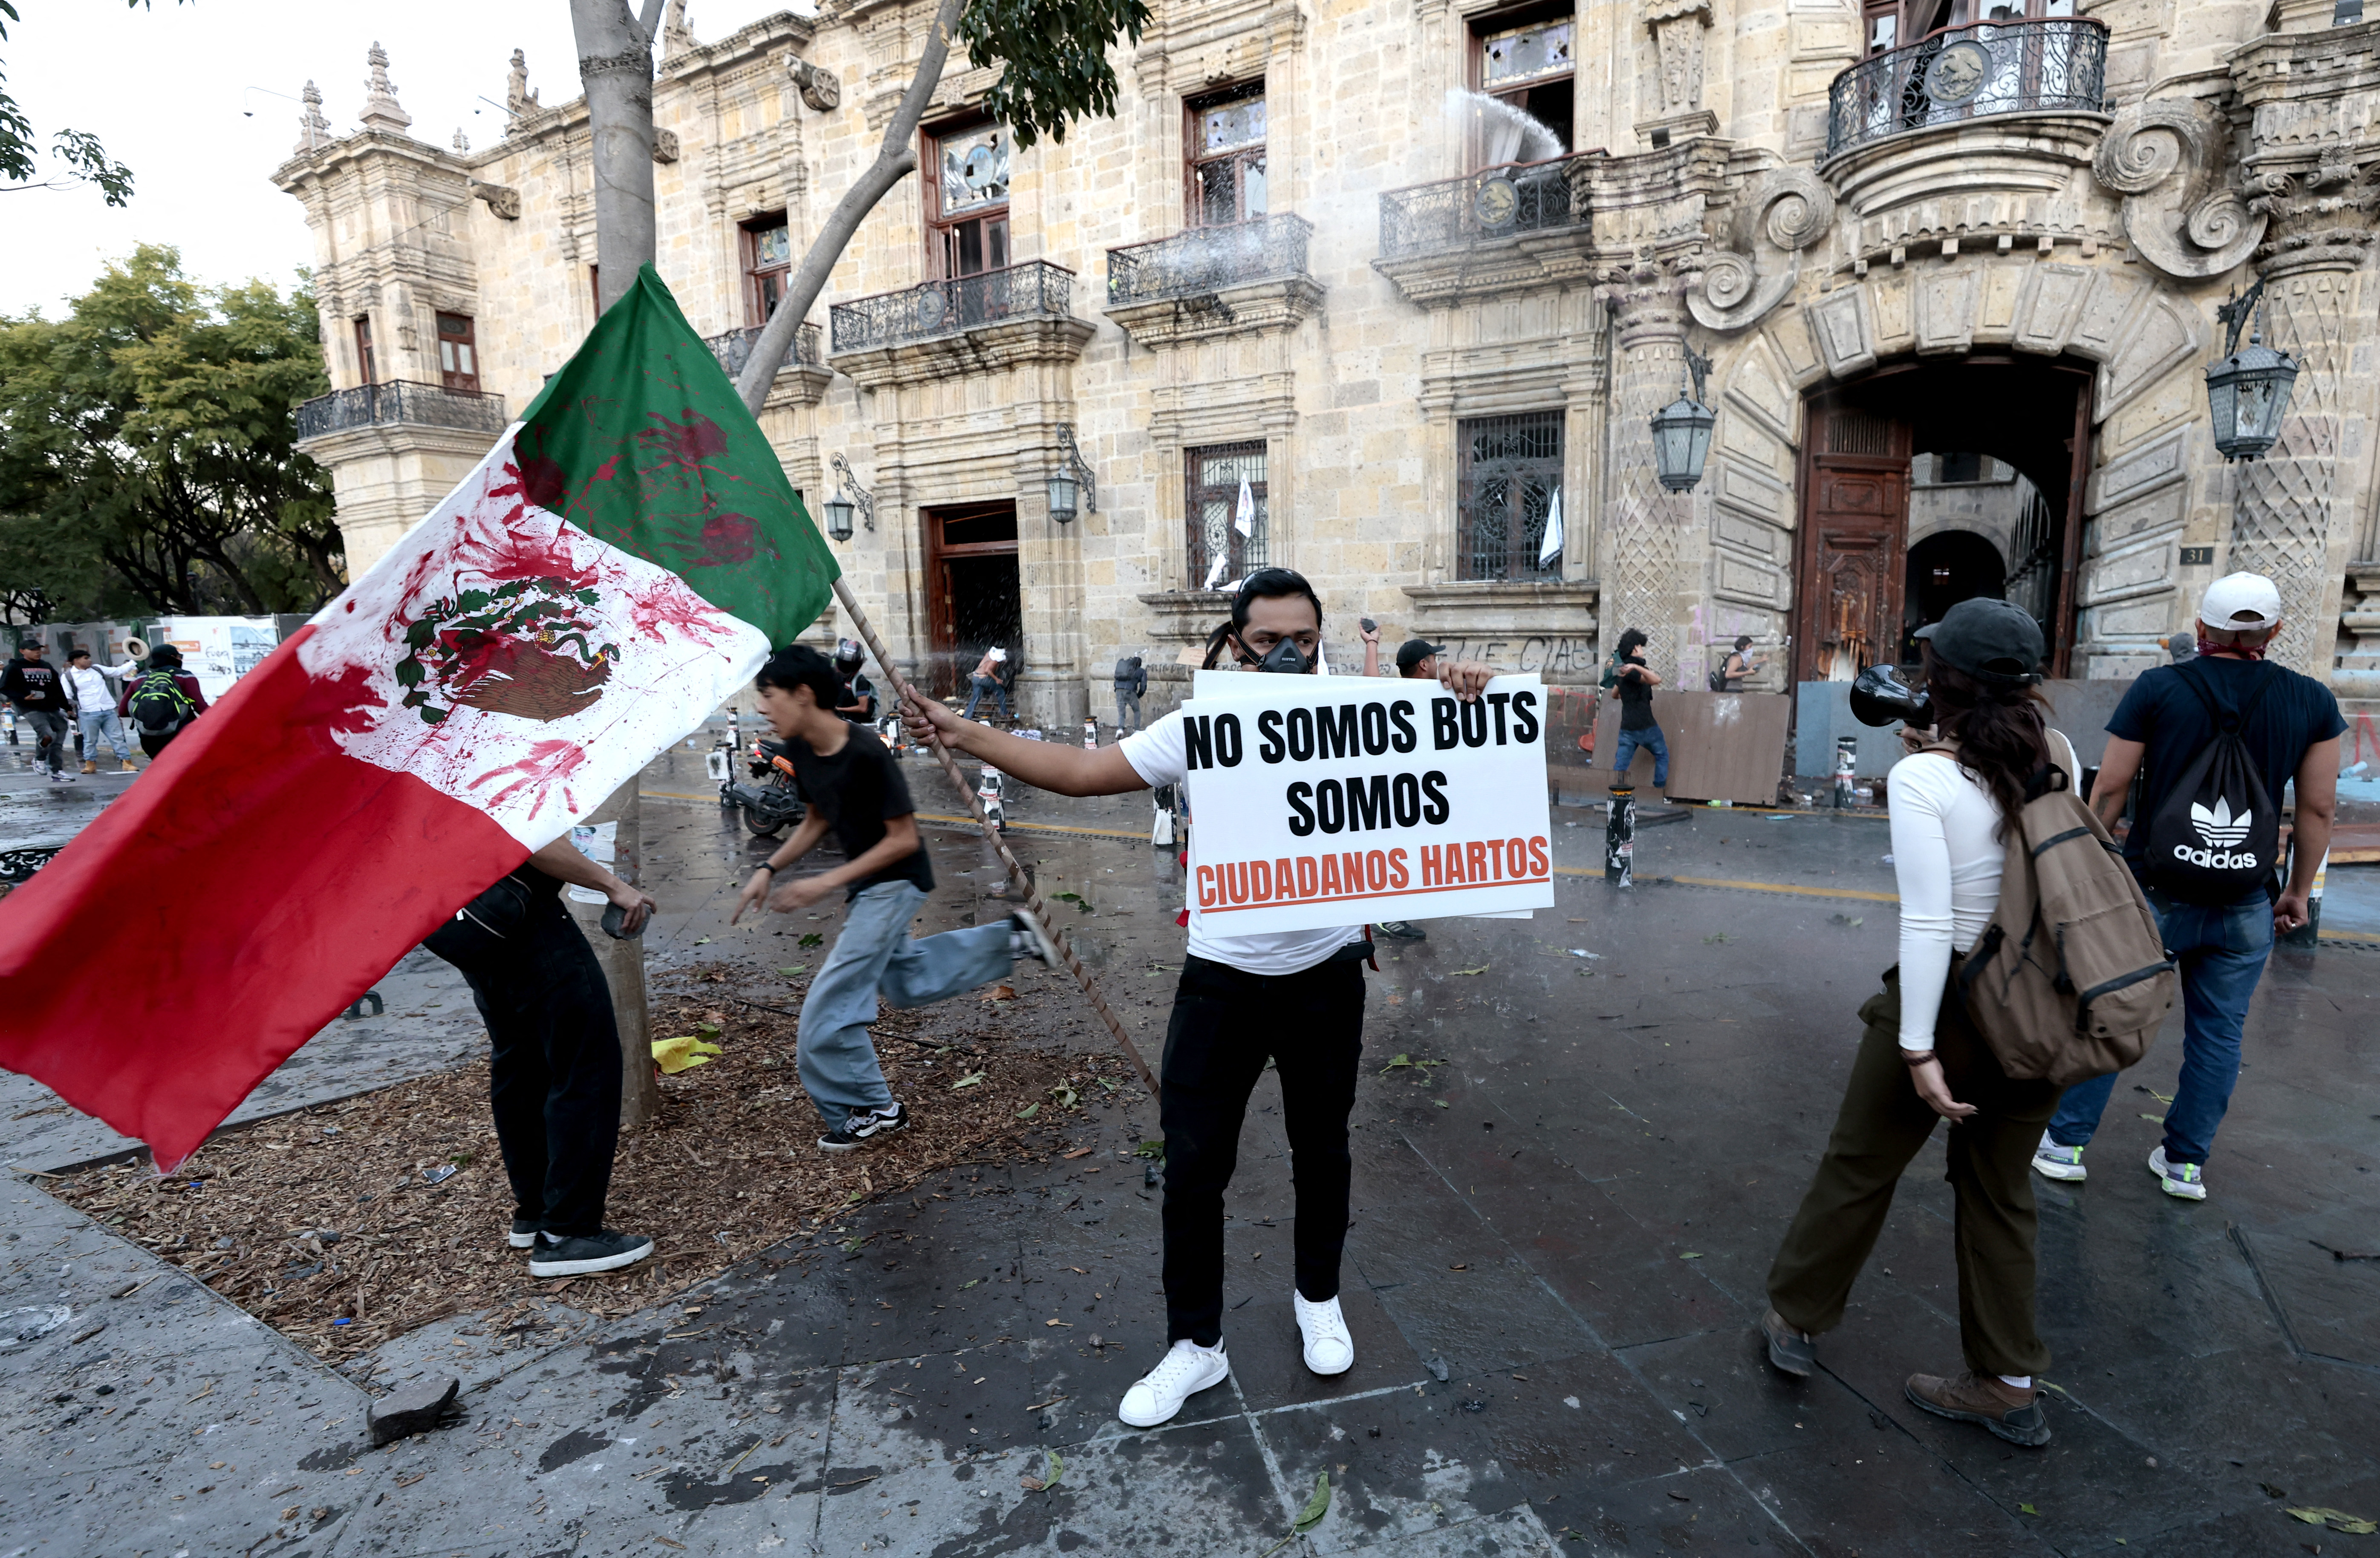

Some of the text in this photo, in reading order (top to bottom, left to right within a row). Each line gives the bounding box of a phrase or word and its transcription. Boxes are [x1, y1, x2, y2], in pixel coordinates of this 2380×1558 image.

[2187, 549, 2203, 562] 31
[1183, 713, 1242, 770] NO
[1258, 700, 1417, 764] SOMOS
[1431, 691, 1539, 750] BOTS
[1287, 770, 1449, 836] SOMOS
[1196, 836, 1549, 907] CIUDADANOS HARTOS
[2174, 844, 2257, 869] adidas
